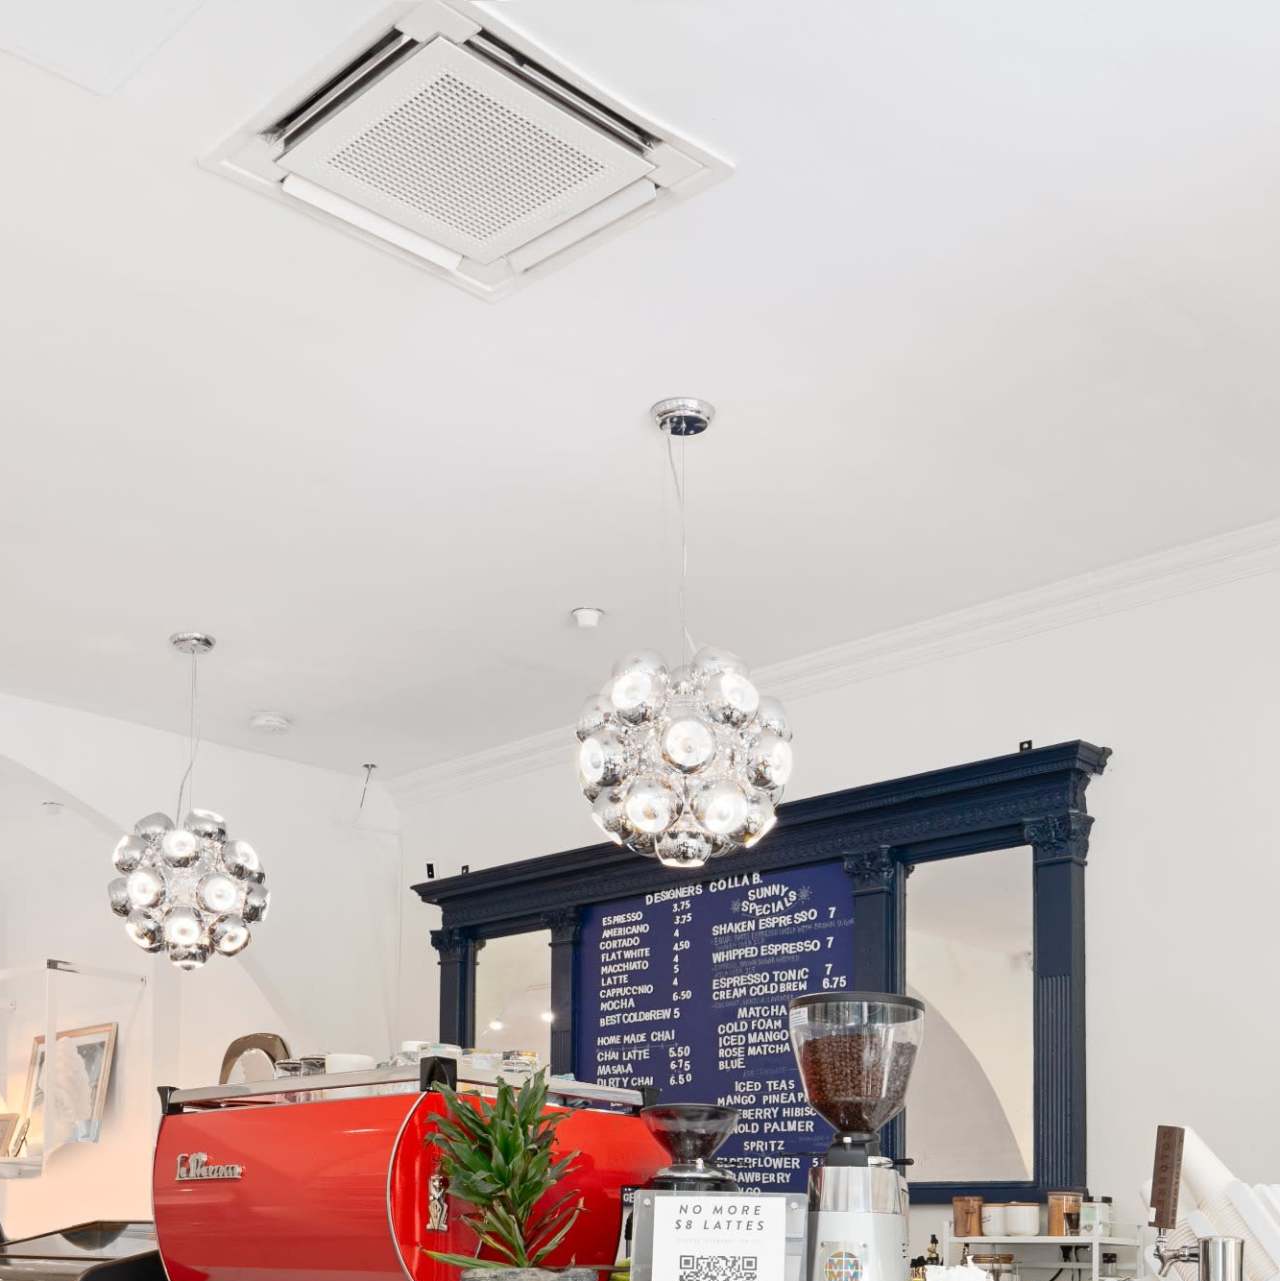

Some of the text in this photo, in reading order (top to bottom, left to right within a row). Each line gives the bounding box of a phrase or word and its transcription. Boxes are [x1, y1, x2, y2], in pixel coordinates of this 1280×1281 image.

[645, 885, 703, 905] DESIGNERS
[748, 884, 789, 901] SUNNY
[741, 890, 797, 916] SPECIALS
[602, 912, 643, 926] ESPRESSO
[712, 920, 755, 936] SHAKEN
[759, 908, 818, 929] ESPRESSO
[828, 907, 837, 919] 7
[602, 924, 650, 939] AMERICANO
[599, 929, 680, 950] CORTADO 4
[601, 951, 623, 963] FLAT
[623, 948, 651, 959] WHITE
[712, 946, 759, 964] WHIPPED
[761, 939, 821, 956] ESPRESSO
[826, 936, 834, 949] 7
[601, 955, 679, 975] MACCHIATO 4
[601, 965, 680, 987] LATTE 5
[673, 977, 679, 986] 4
[712, 963, 833, 990] ESPRESSO TONIC 7
[712, 988, 747, 1001] CREAM
[822, 976, 847, 989] 6.75
[600, 998, 635, 1011] MOCHA
[737, 1004, 788, 1019] MATCHA
[600, 1014, 622, 1028] BEST
[673, 1008, 681, 1019] 5
[718, 1018, 782, 1035] COLD FOAM
[597, 1029, 675, 1047] HOME MADE CHAI
[718, 1029, 789, 1047] ICED MANGO
[597, 1050, 619, 1062] CHAI
[622, 1049, 650, 1060] LATTE
[718, 1042, 791, 1059] ROSE MATCHA
[597, 1063, 634, 1076] MASALA
[631, 1075, 654, 1087] CHAI
[735, 1079, 795, 1093] ICED TEAS
[717, 1094, 756, 1107] MANGO
[782, 1106, 817, 1118] HIBISC
[764, 1120, 814, 1133] PALMER
[743, 1140, 785, 1152] SPRITZ
[679, 1204, 762, 1216] NO MORE
[674, 1219, 765, 1231] $8 LATTES
